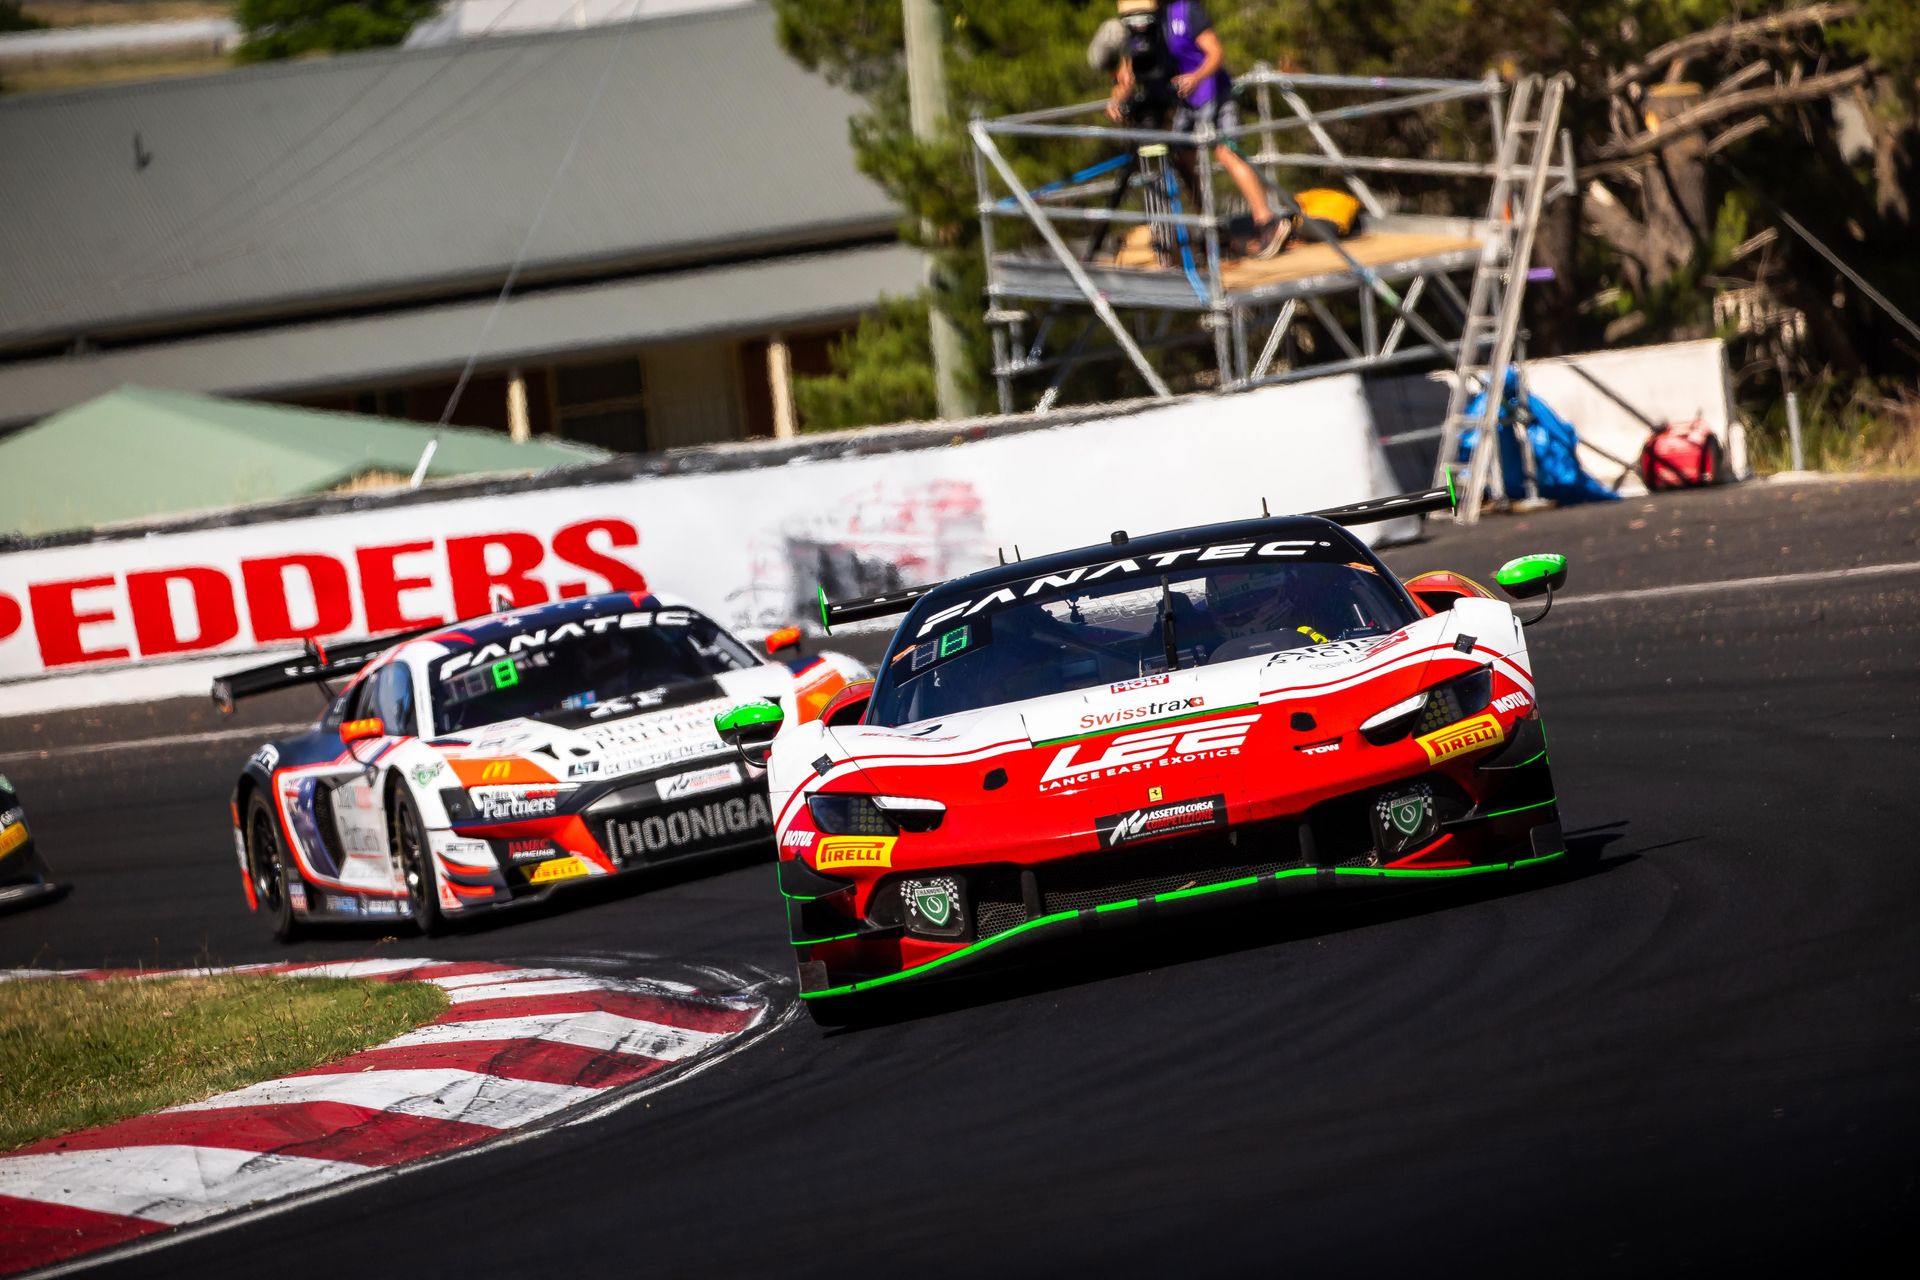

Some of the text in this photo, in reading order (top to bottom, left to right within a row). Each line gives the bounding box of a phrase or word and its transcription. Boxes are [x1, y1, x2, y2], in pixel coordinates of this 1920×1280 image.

[439, 610, 693, 681] FANATEC
[491, 656, 520, 689] 8
[1112, 676, 1169, 693] MOLY
[1080, 697, 1192, 729] Swisstrax
[1491, 690, 1530, 714] MOTUL
[1039, 713, 1263, 783] LEE
[1302, 743, 1340, 755] TOW
[1427, 720, 1498, 759] PIRELLI
[1039, 746, 1241, 793] LANCE EAST EXOTICS
[482, 796, 557, 819] Partners
[1147, 800, 1214, 821] ASSETTO CORSA
[1145, 810, 1214, 831] COMPETIZIONE
[782, 830, 816, 847] MOTUL
[820, 841, 886, 864] PIRELLI
